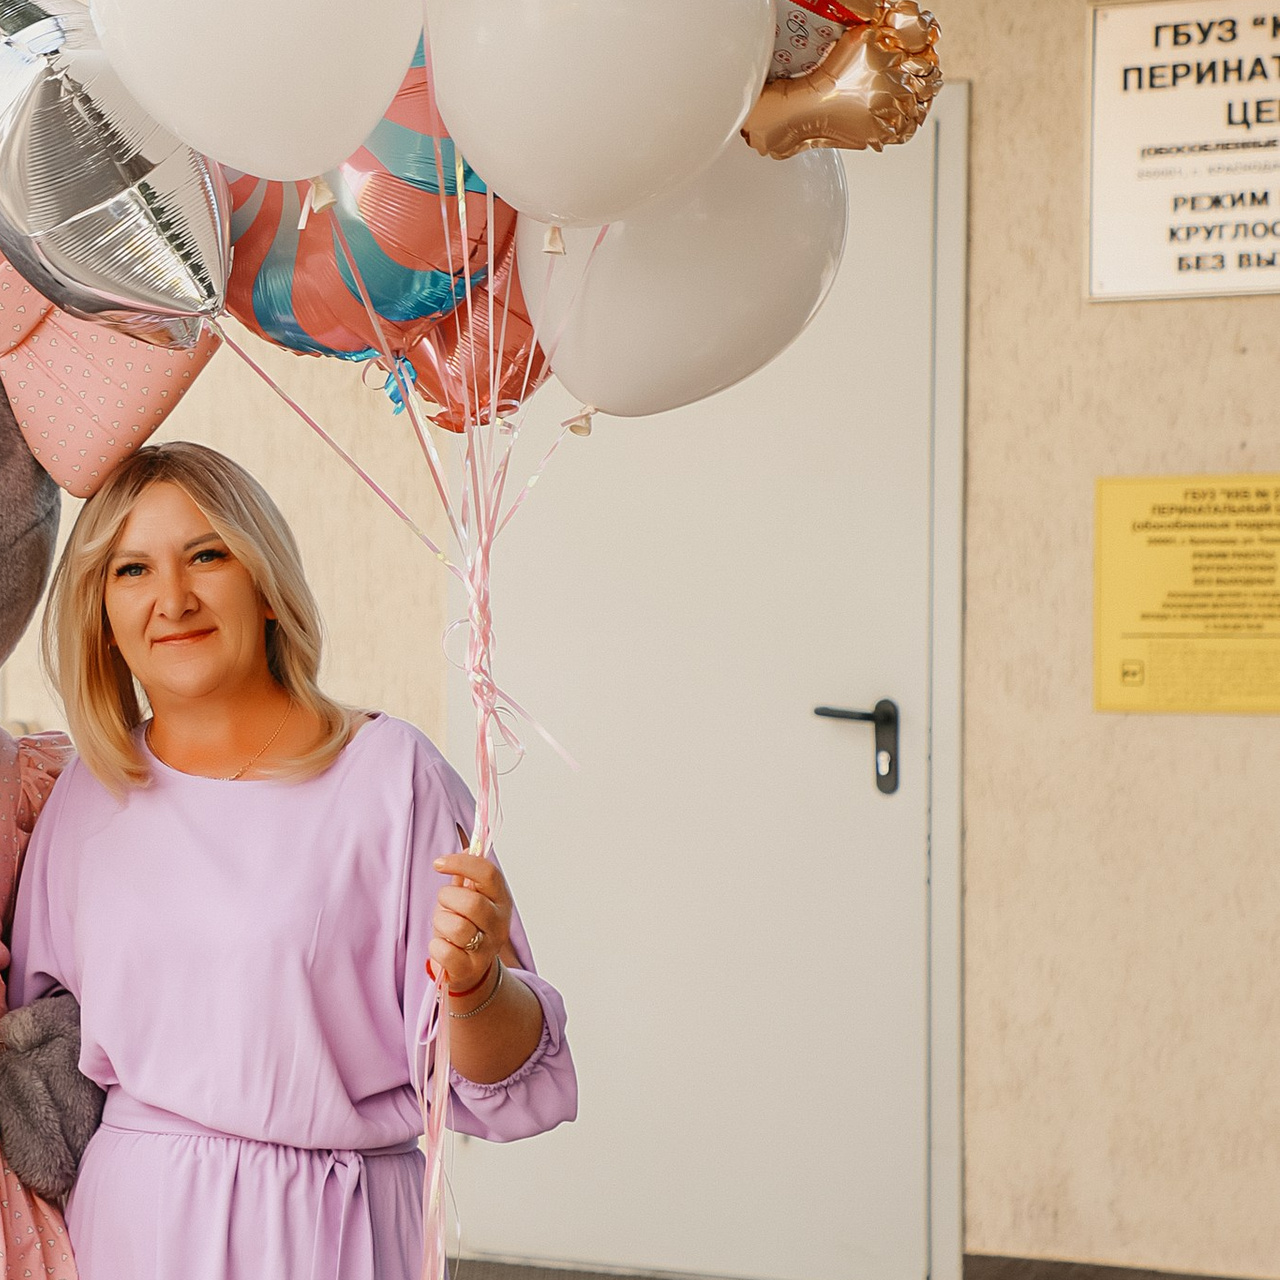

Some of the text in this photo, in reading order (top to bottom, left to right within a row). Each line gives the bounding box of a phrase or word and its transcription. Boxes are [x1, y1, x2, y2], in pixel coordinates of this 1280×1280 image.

[1154, 19, 1237, 47] ГБУЗ
[1227, 99, 1280, 130] ЦЕ
[1173, 191, 1269, 212] РЕЖИМ
[1178, 252, 1280, 271] БЕЗ ВЫ
